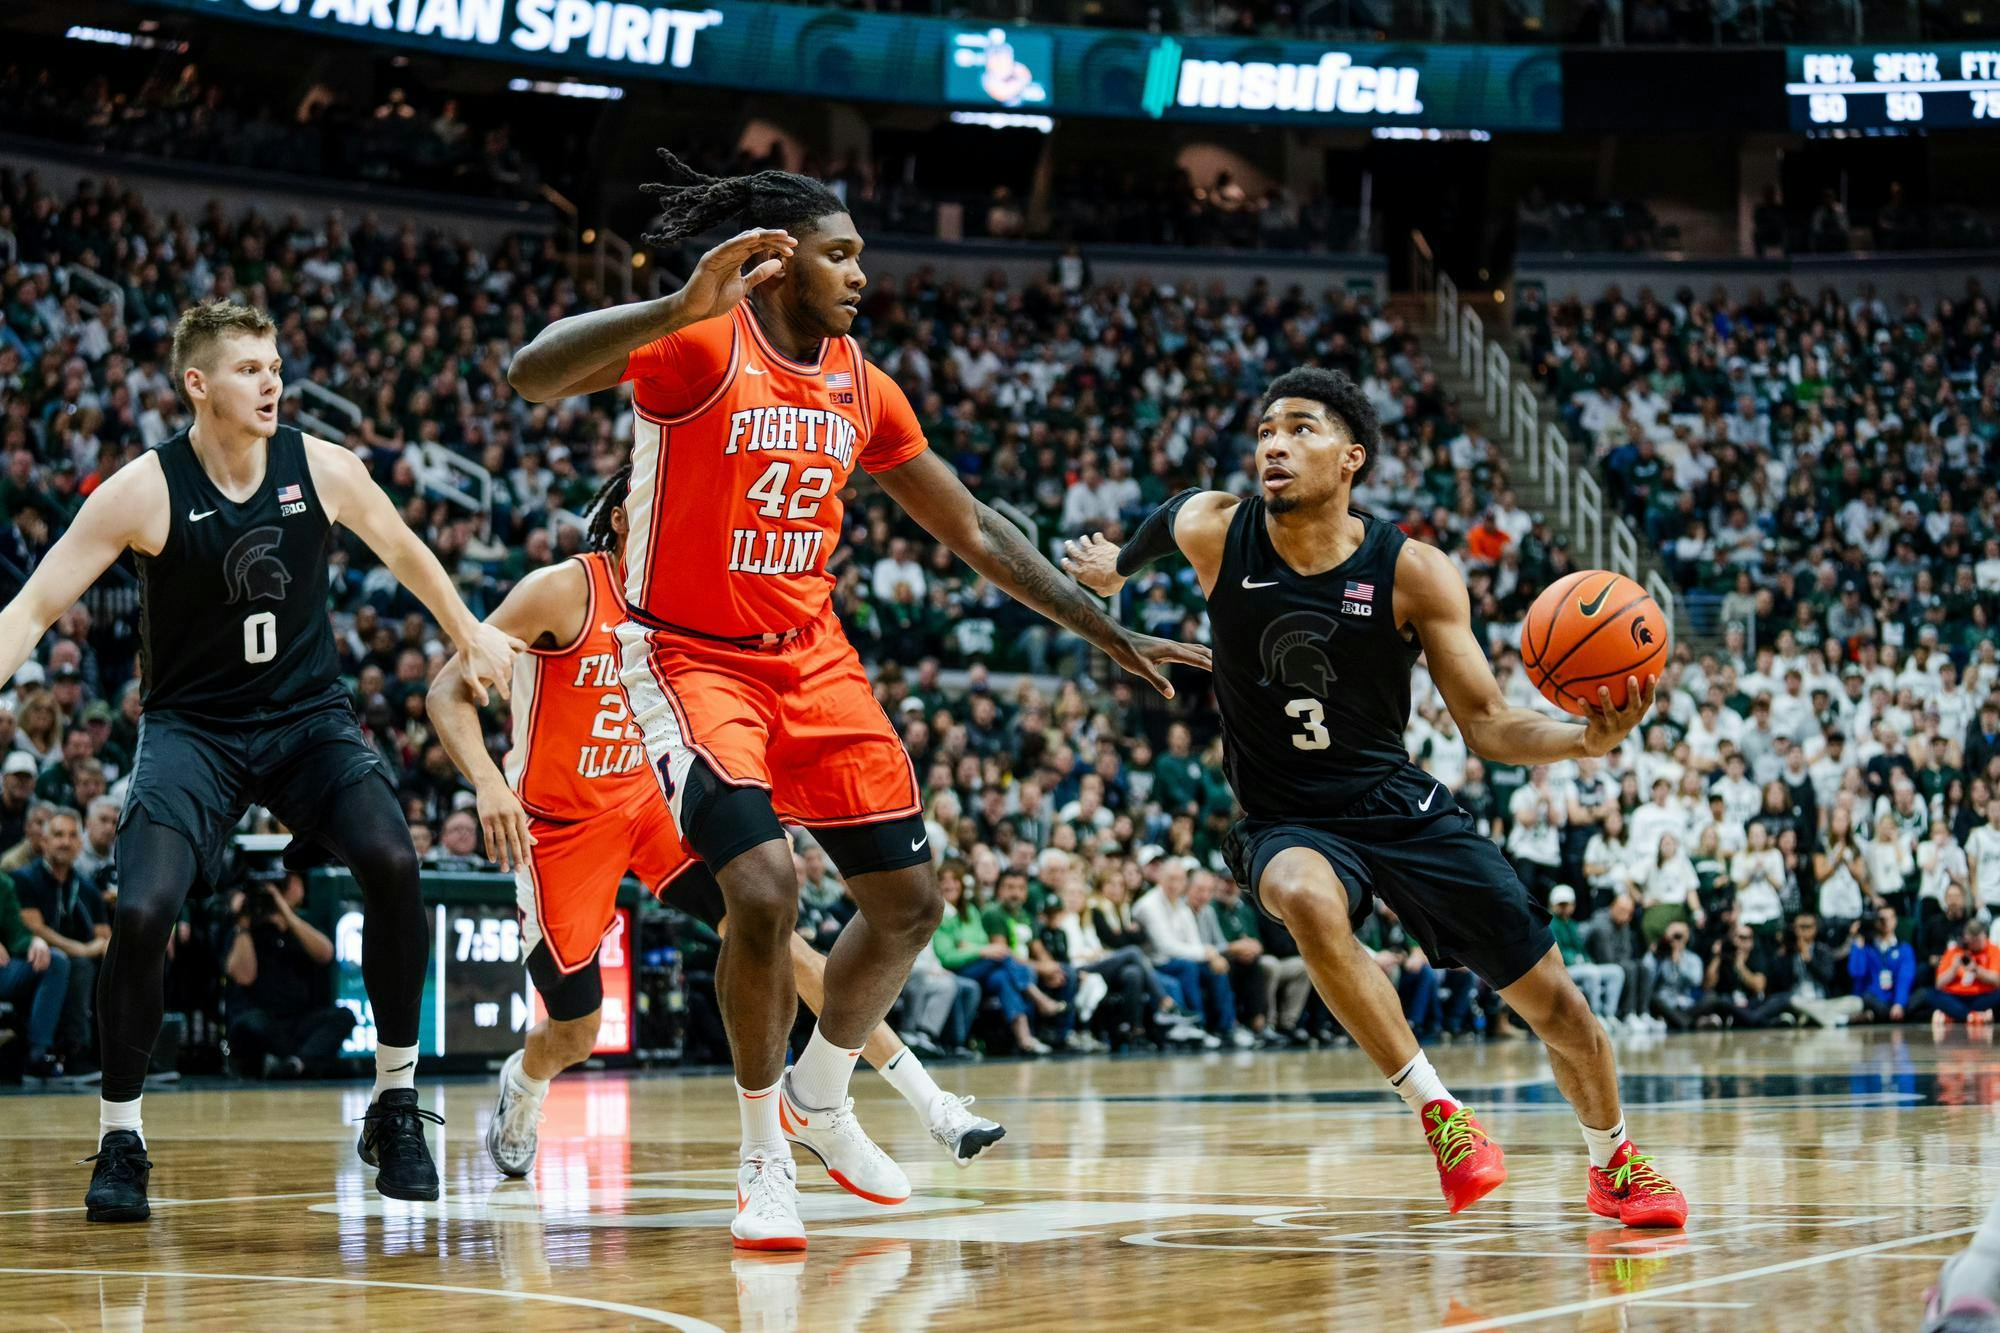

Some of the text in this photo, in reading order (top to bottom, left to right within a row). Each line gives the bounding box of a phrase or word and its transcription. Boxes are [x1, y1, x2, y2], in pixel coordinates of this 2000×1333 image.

[724, 406, 856, 470] FIGHTING
[746, 461, 833, 520] 42
[729, 529, 823, 575] ILLINI
[243, 611, 277, 664] 0
[1284, 698, 1332, 751] 3
[454, 918, 520, 962] 7:56
